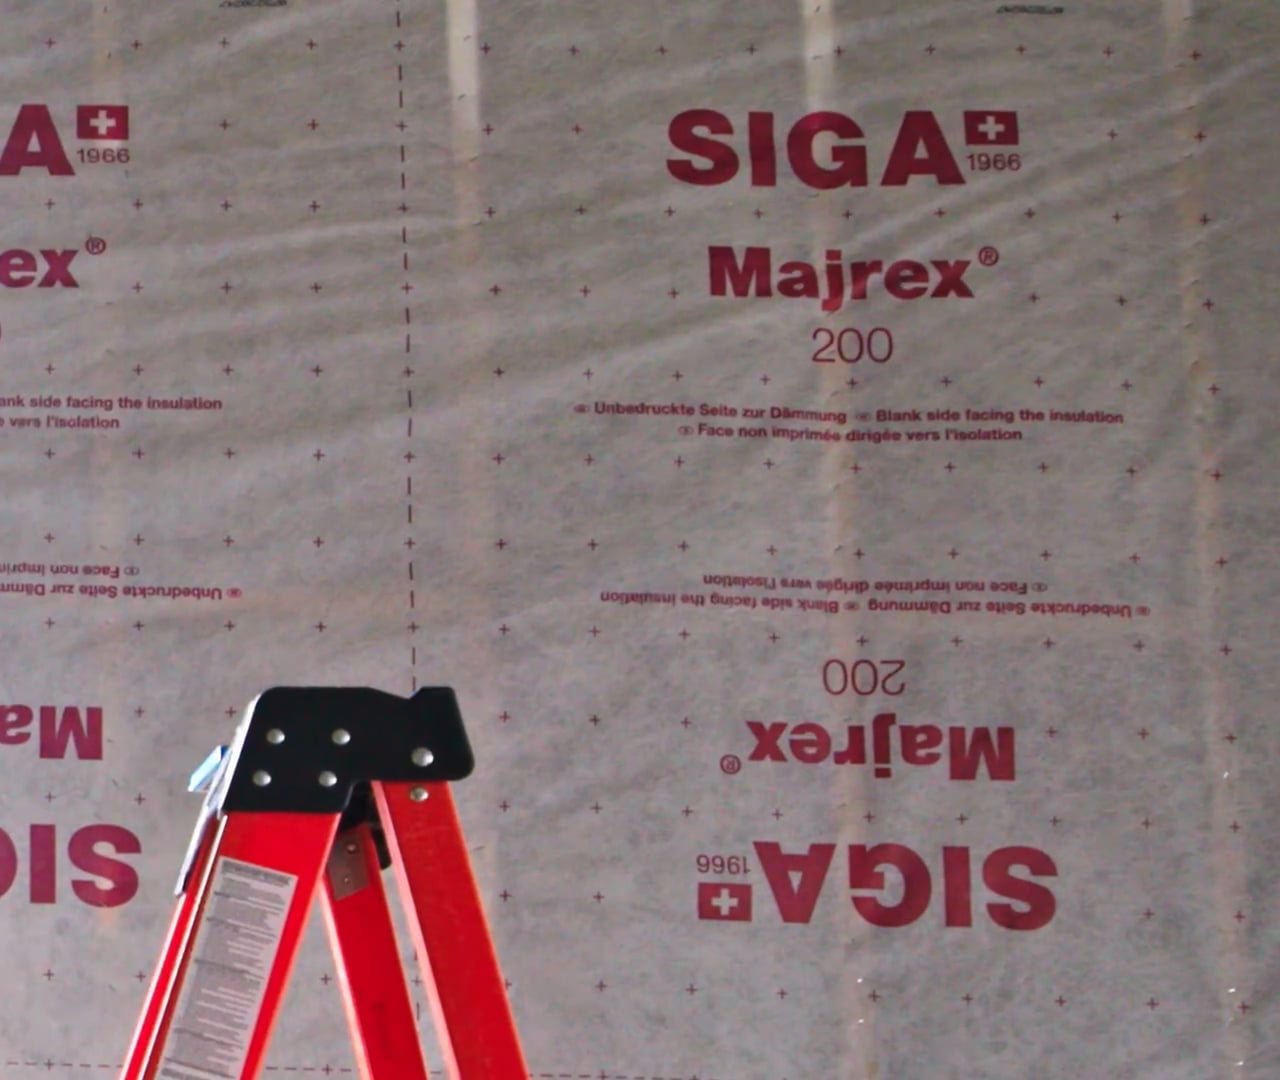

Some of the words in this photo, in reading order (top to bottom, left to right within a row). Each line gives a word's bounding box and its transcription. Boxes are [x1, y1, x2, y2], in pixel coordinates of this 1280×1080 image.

[77, 148, 130, 164] 1966
[666, 109, 966, 190] SIGA
[966, 153, 1022, 172] 1966
[810, 327, 894, 364] 200
[30, 396, 62, 409] side
[66, 397, 113, 411] facing
[118, 397, 143, 410] the
[147, 397, 222, 410] insulation
[594, 403, 695, 416] Unbedruckte
[699, 406, 738, 417] Seite
[741, 408, 765, 419] zur
[770, 407, 847, 425] Dämmung
[876, 410, 921, 422] Blank
[927, 410, 961, 422] side
[965, 410, 1014, 425] facing
[1020, 410, 1045, 422] the
[1049, 409, 1123, 424] insulation
[9, 416, 41, 428] vers
[697, 424, 734, 437] Face
[738, 427, 767, 438] non
[905, 431, 940, 441] vers
[50, 564, 79, 576] non
[83, 565, 120, 579] Face
[50, 584, 74, 595] zur
[79, 584, 118, 597] Seite
[781, 579, 812, 589] vers
[955, 582, 985, 592] non
[990, 582, 1027, 595] Face
[123, 585, 222, 600] Unbedruckte
[600, 591, 676, 605] insulation
[681, 593, 705, 606] the
[710, 593, 757, 608] facing
[762, 596, 794, 609] side
[798, 599, 839, 613] Blank
[868, 598, 951, 614] Dämmung
[956, 601, 981, 612] zur
[986, 602, 1027, 614] Seite
[1031, 602, 1132, 618] Unbedruckte
[822, 659, 907, 696] 200
[696, 854, 751, 875] 1966
[752, 841, 1058, 931] SIGA
